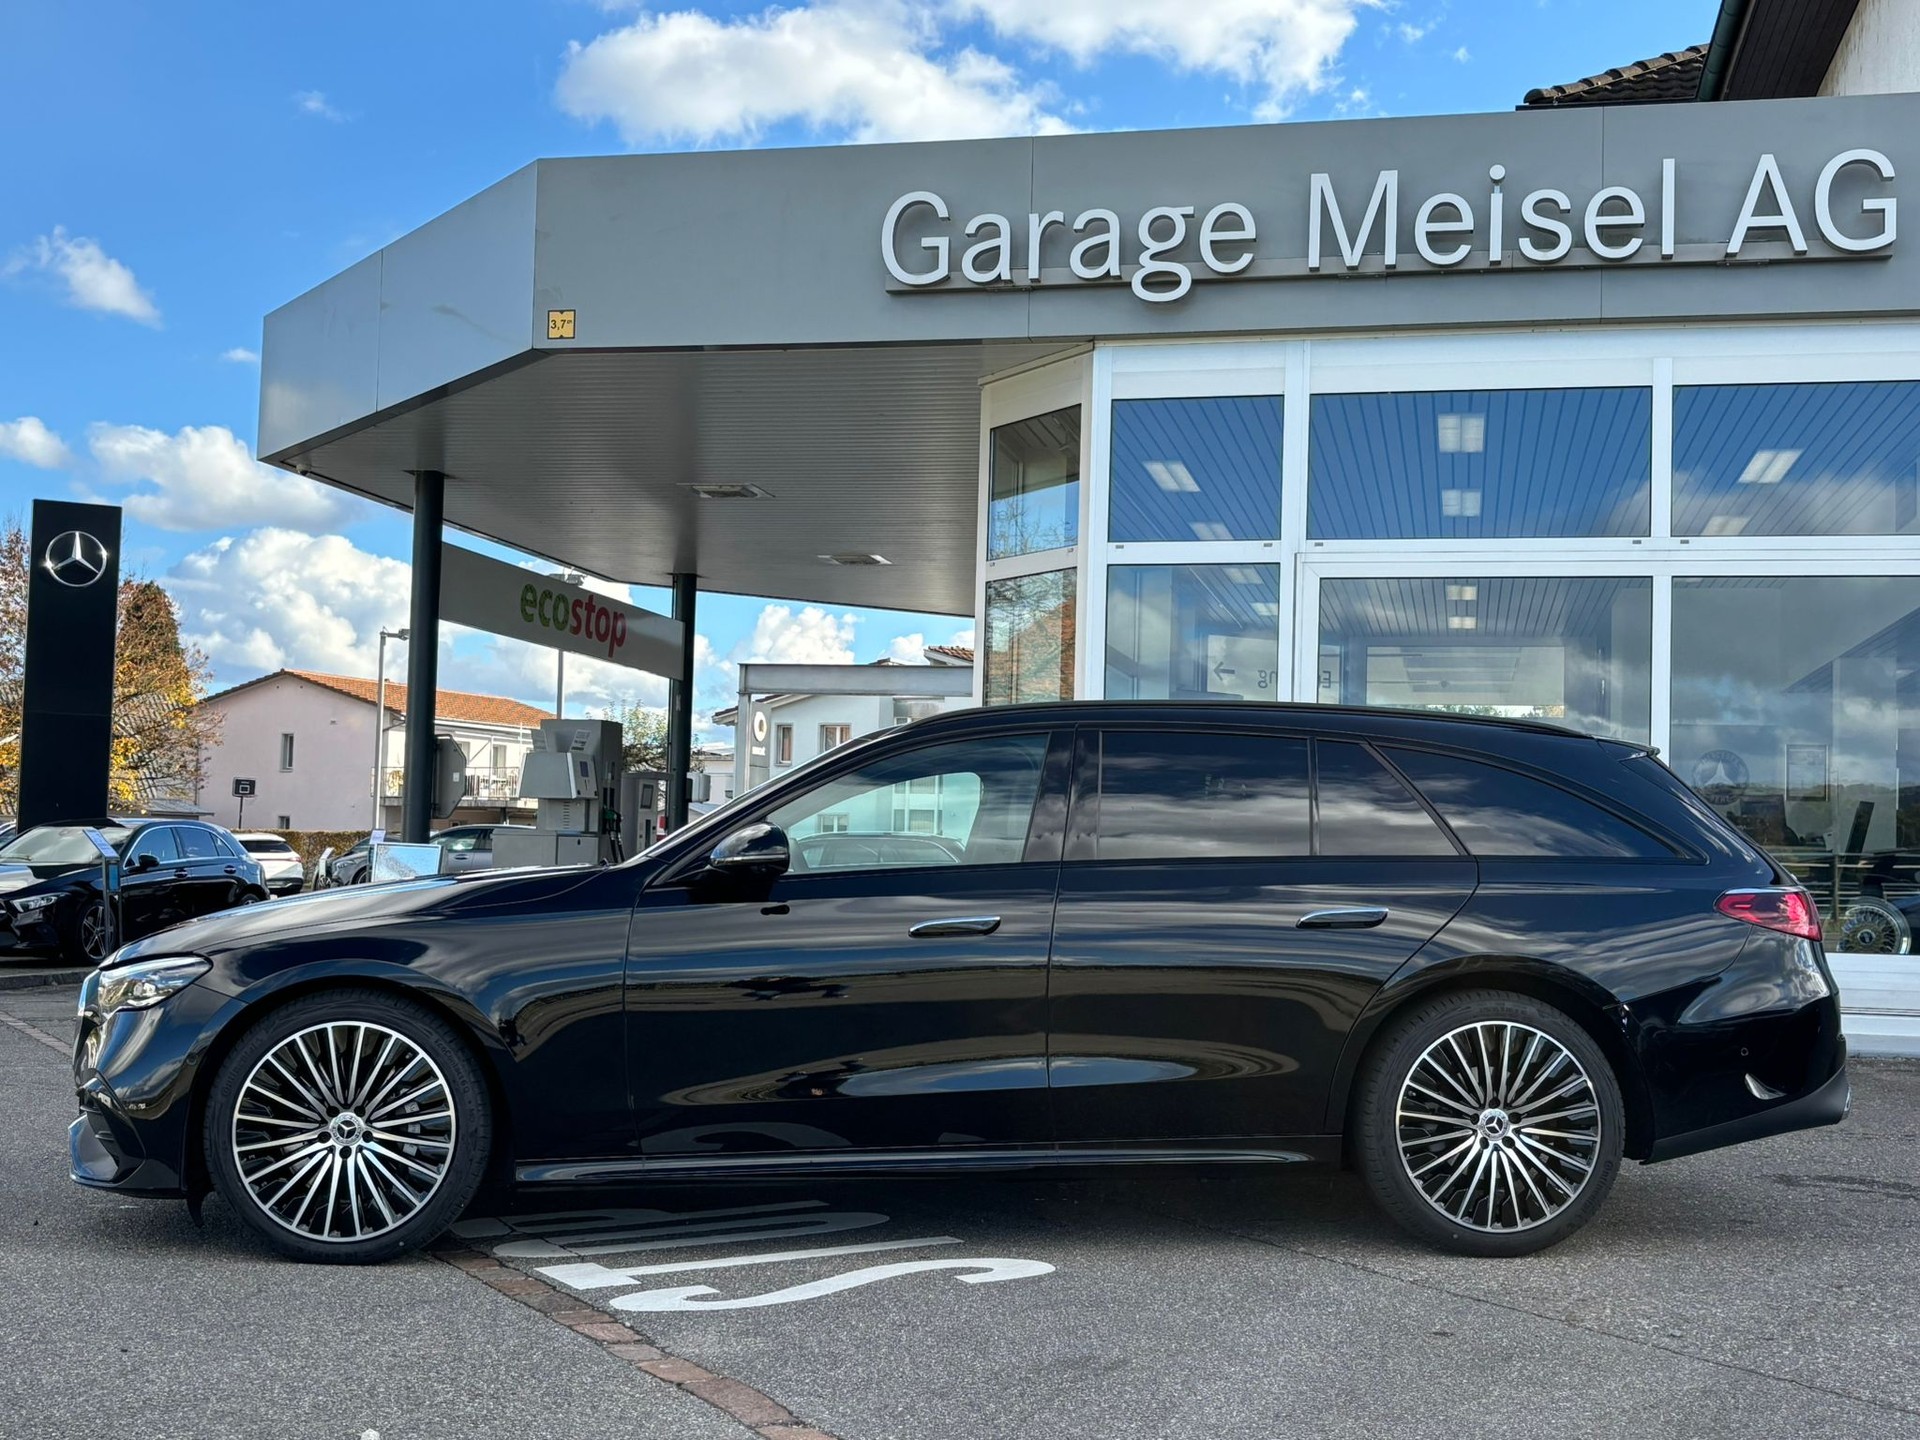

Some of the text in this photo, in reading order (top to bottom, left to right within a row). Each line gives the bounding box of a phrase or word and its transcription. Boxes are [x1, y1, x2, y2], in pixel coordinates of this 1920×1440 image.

[881, 148, 1898, 302] Garage Meisel AG
[520, 584, 627, 658] ecostop
[450, 1200, 1057, 1312] STOP
